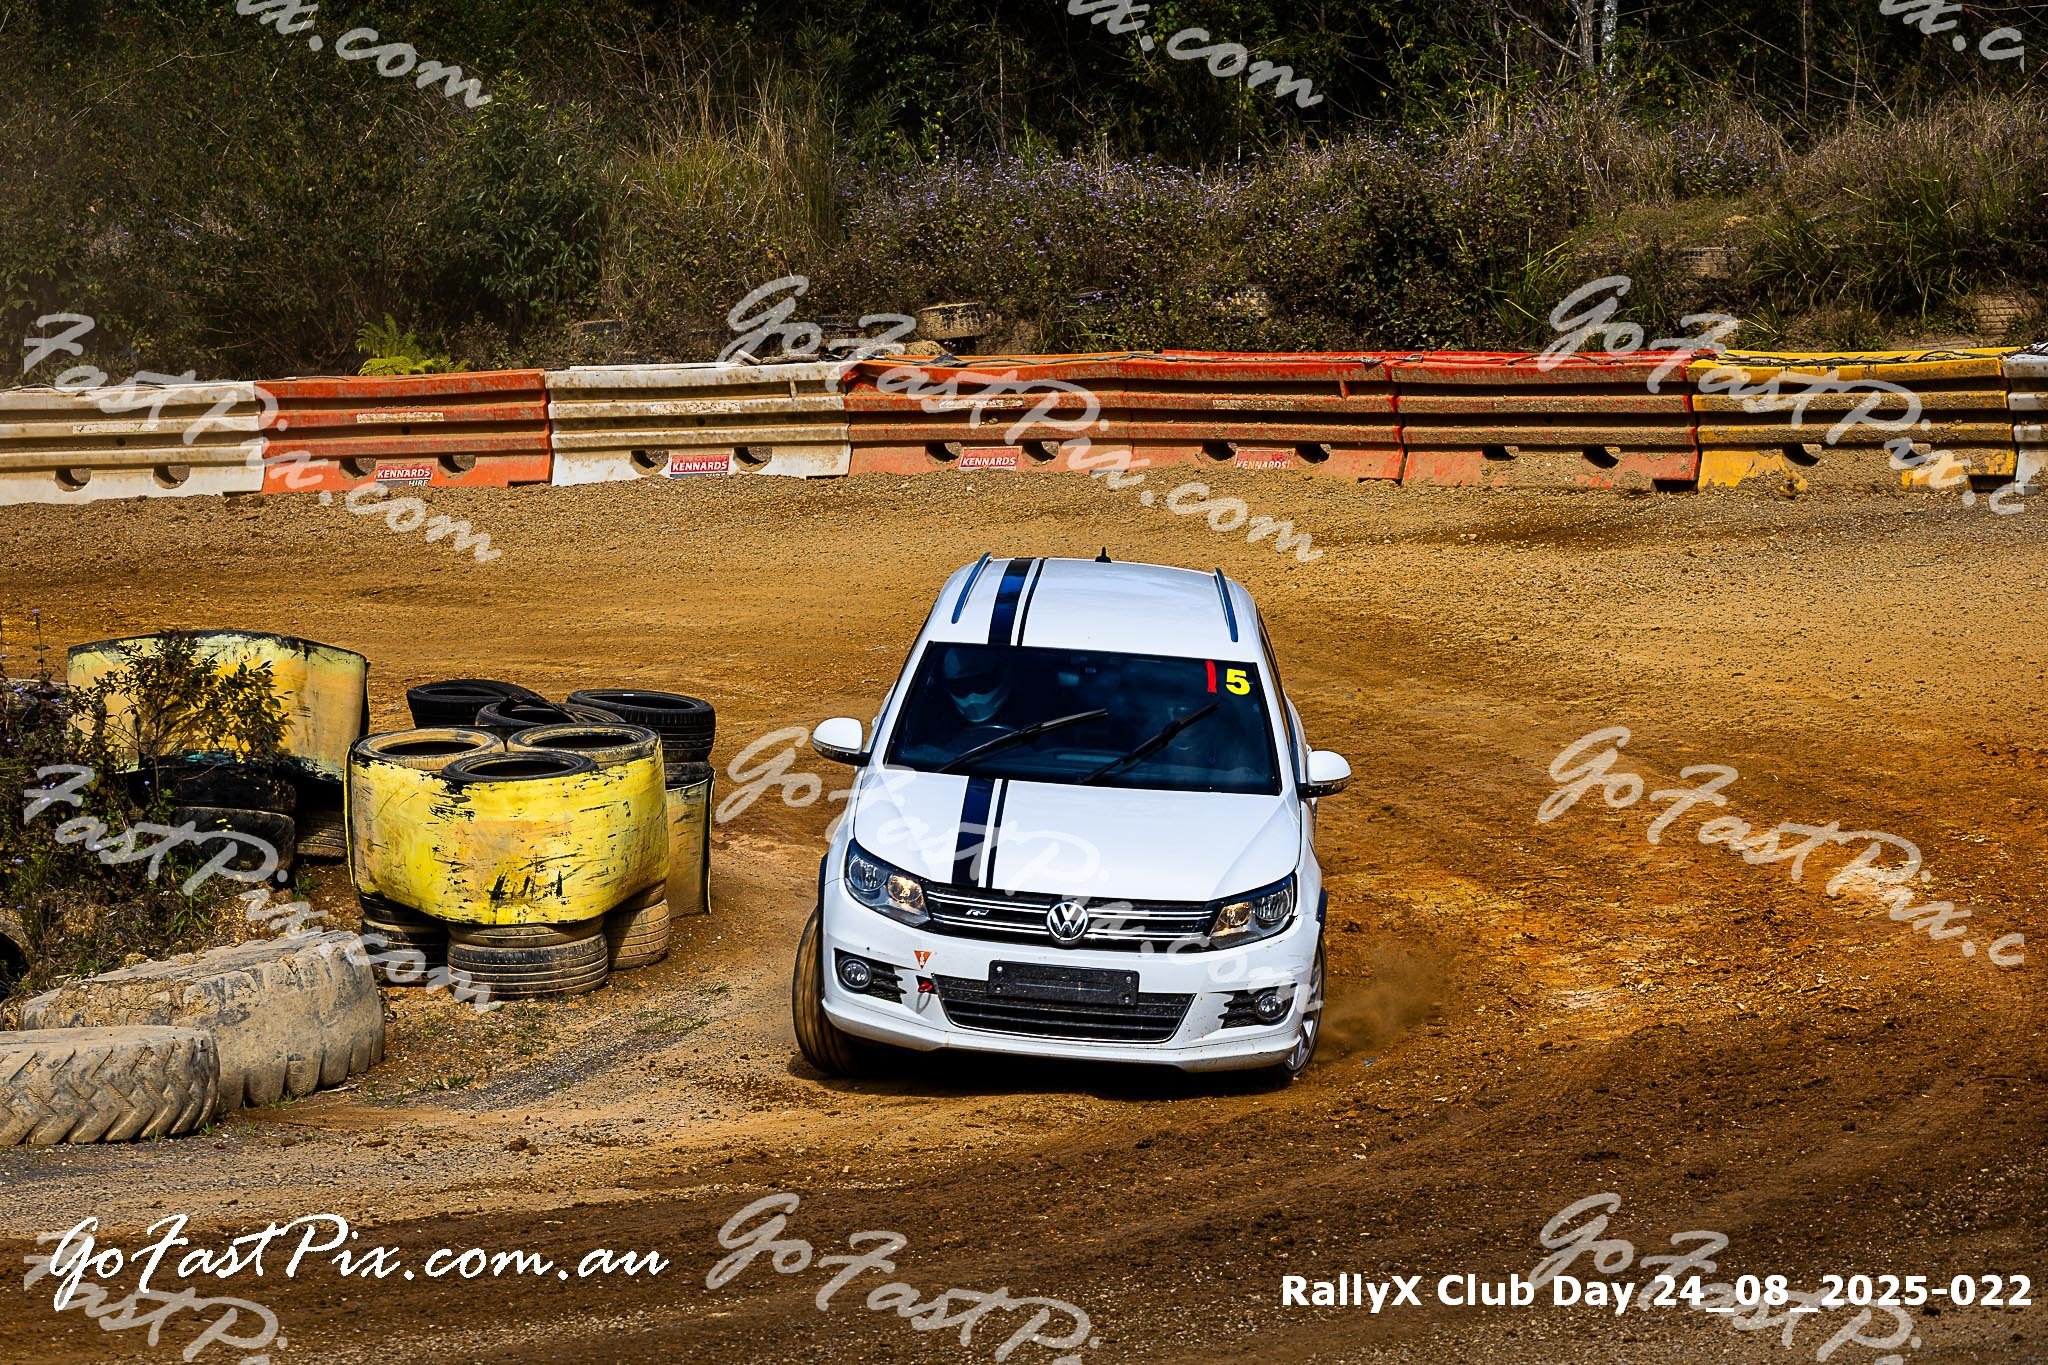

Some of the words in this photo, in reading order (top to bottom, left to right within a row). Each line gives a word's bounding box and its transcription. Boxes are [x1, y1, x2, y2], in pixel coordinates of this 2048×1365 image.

[672, 461, 728, 471] KENNARDS
[962, 457, 1016, 466] KENNARDS
[377, 468, 431, 479] KENNARDS
